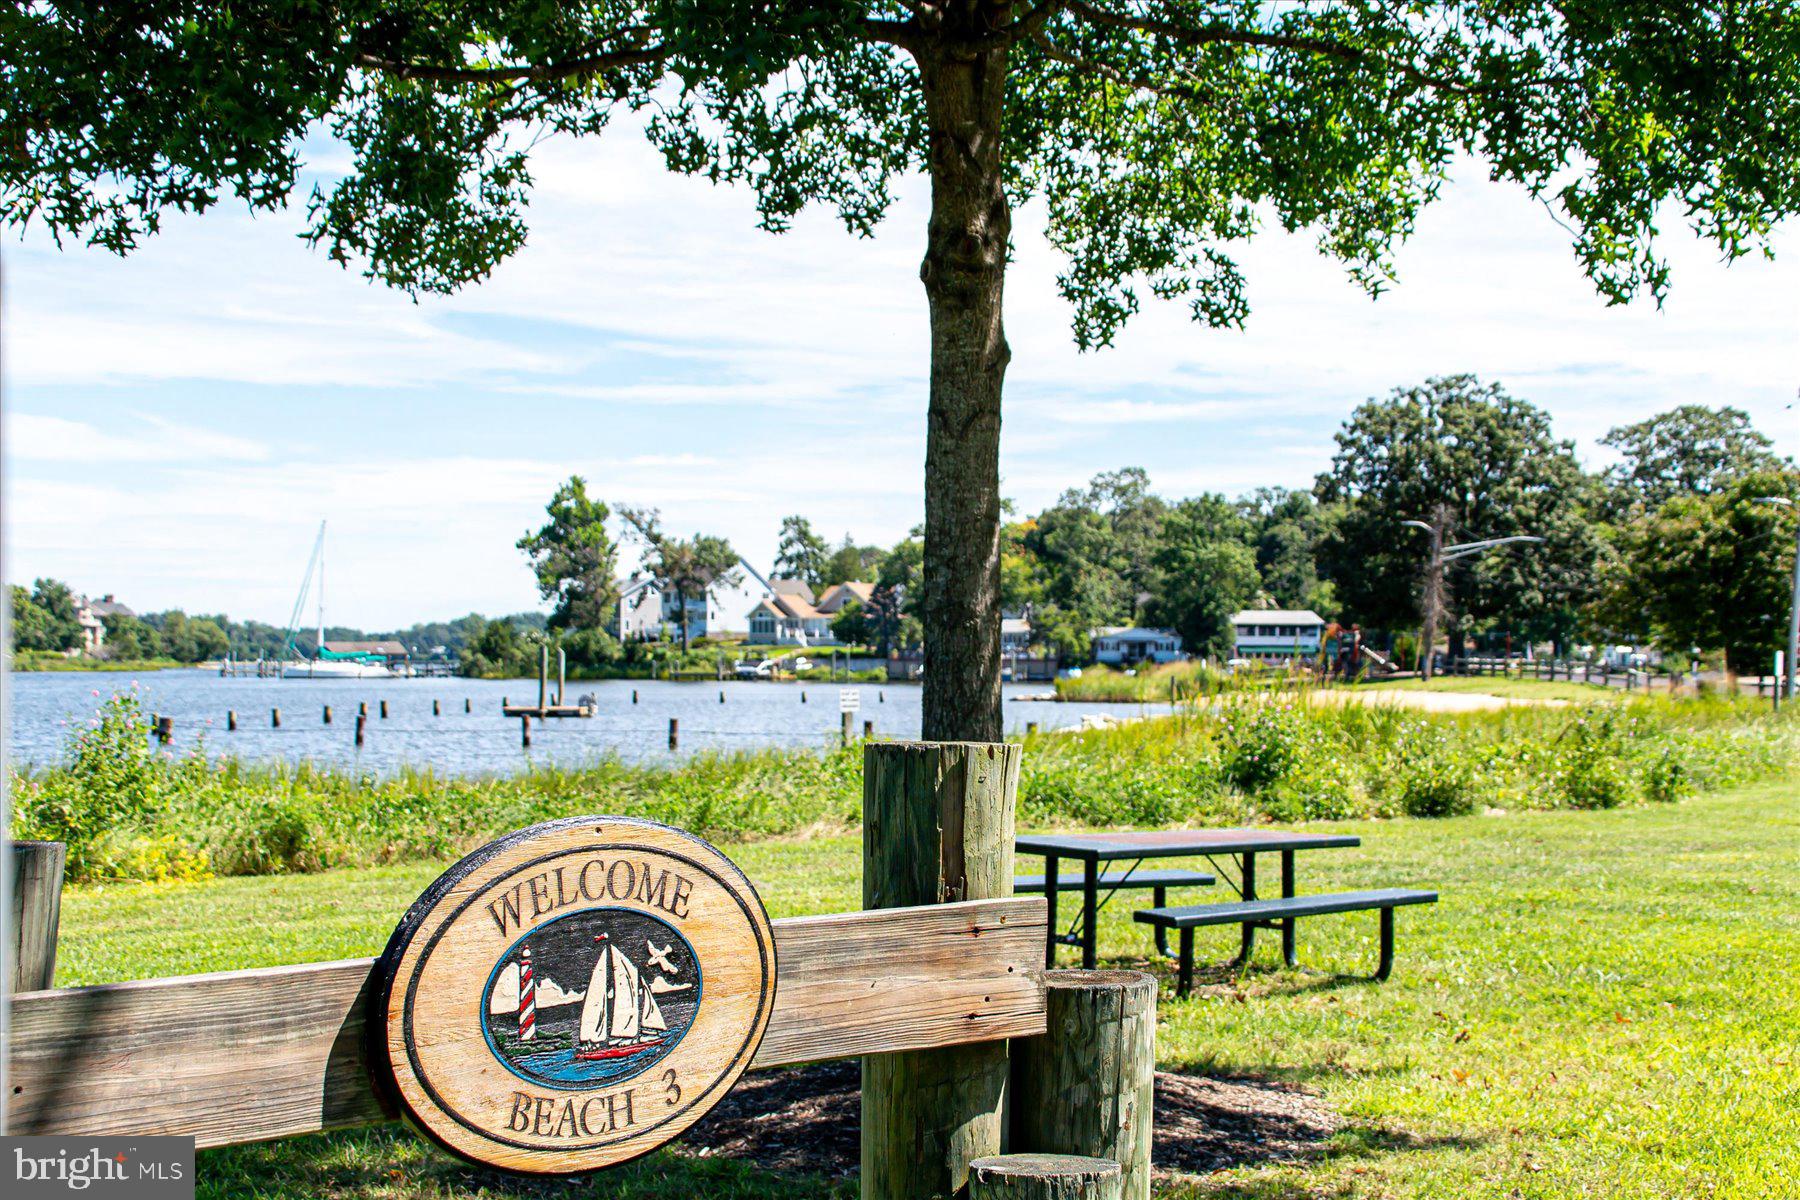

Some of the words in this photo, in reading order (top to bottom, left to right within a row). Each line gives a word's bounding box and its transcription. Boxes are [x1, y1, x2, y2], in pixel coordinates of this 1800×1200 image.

[486, 859, 693, 937] WELCOME
[506, 1090, 636, 1138] BEACH
[661, 1068, 682, 1105] 3
